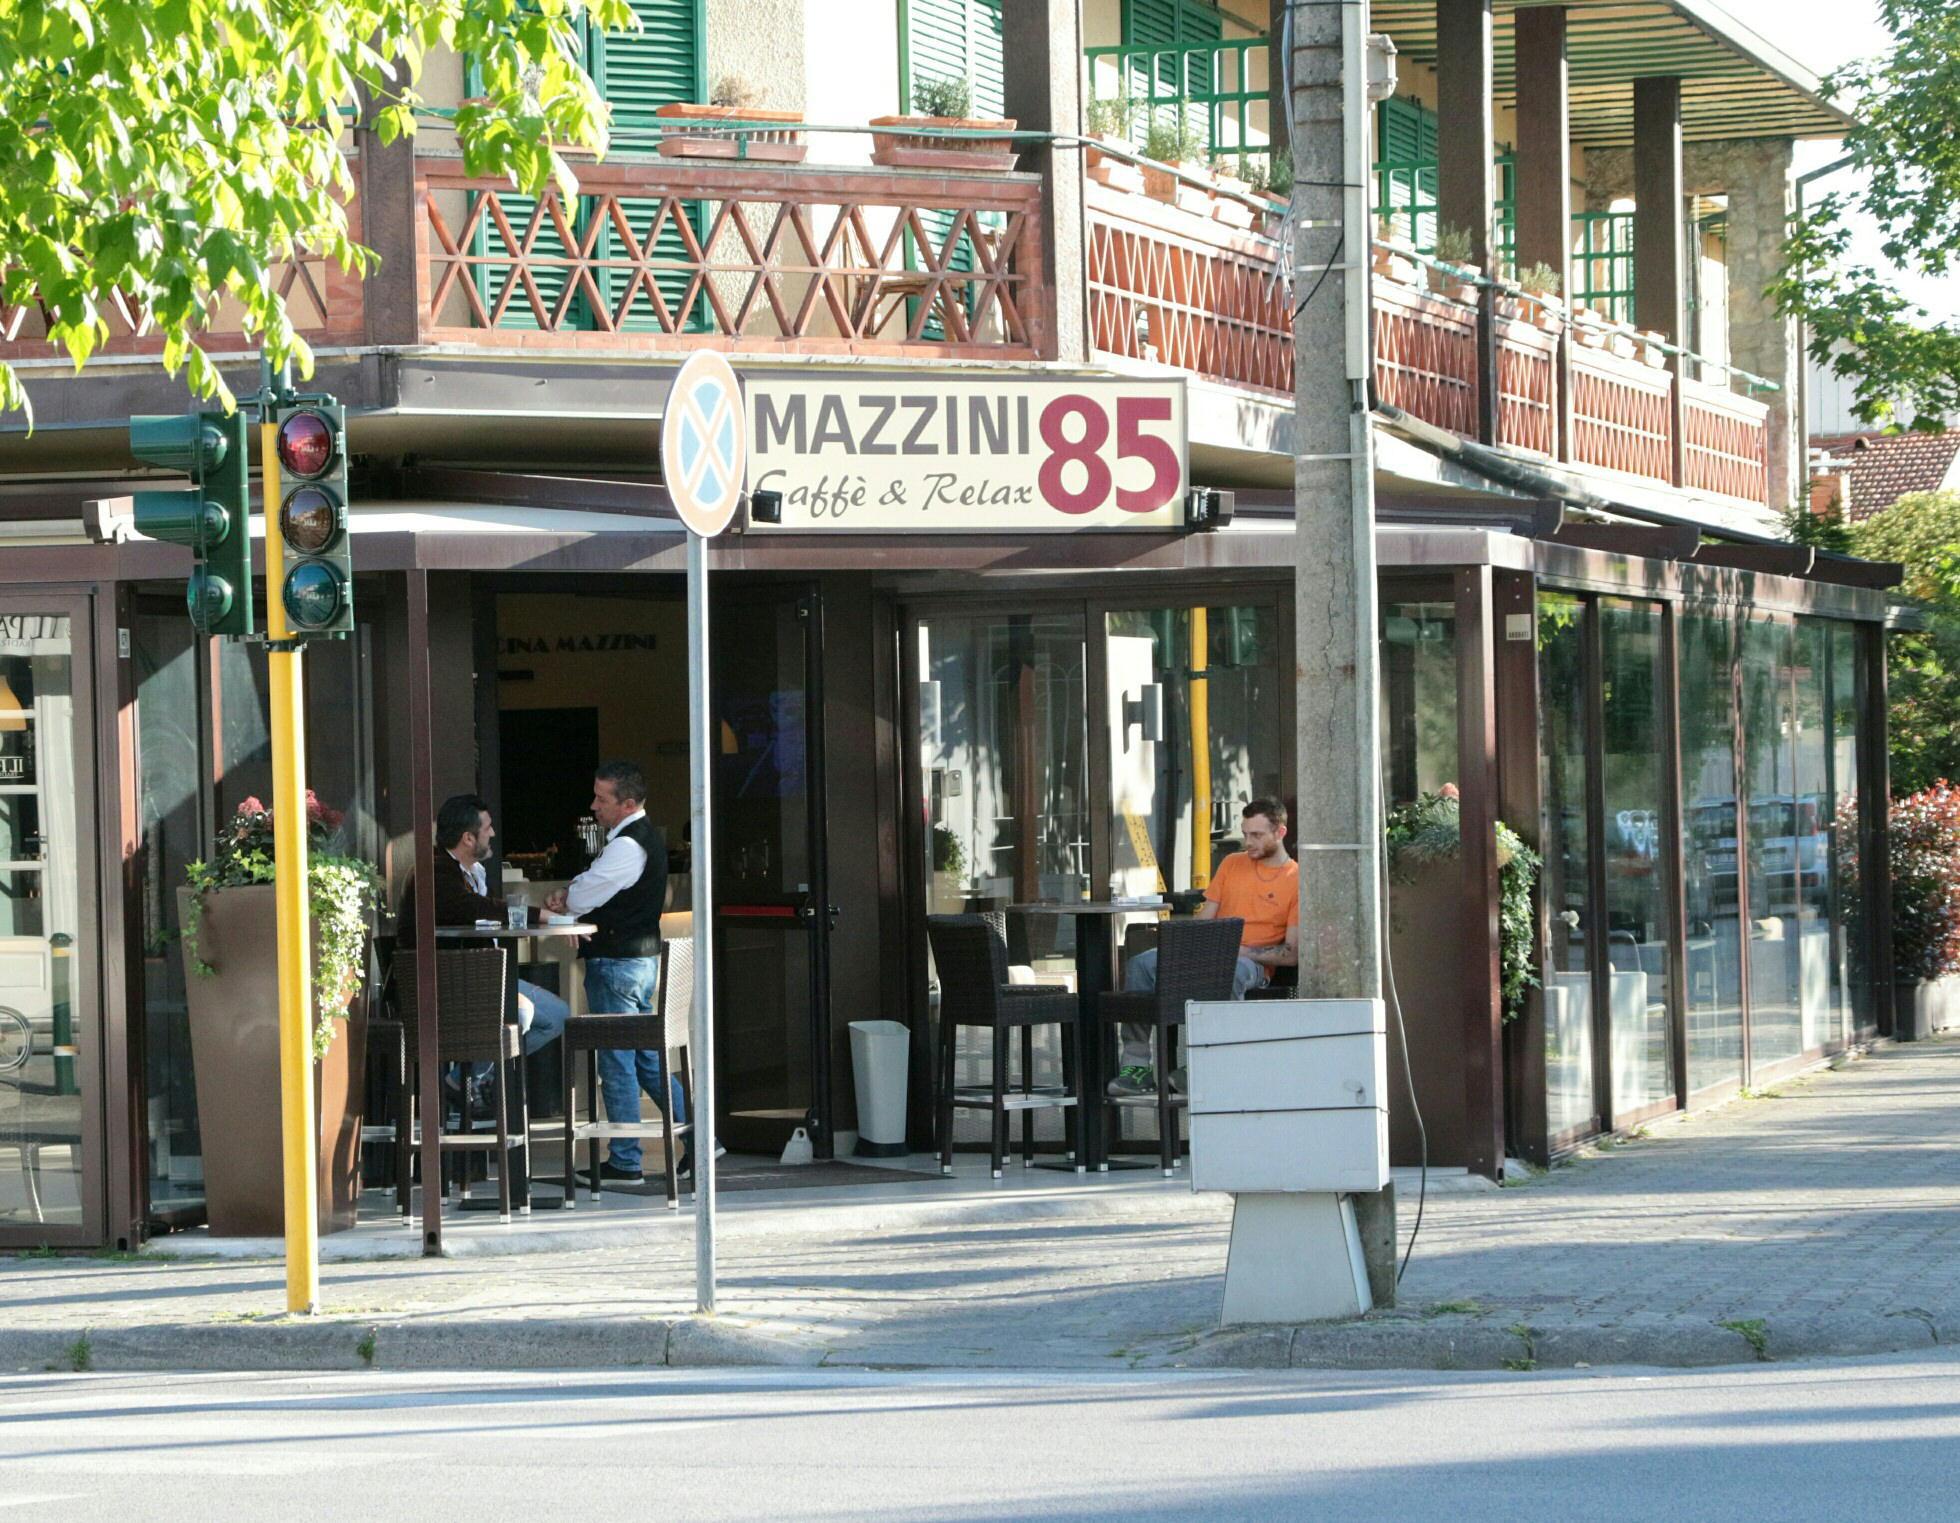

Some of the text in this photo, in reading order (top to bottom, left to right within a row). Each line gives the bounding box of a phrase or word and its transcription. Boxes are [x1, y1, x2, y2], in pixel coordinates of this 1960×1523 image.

[755, 393, 1181, 514] MAZZINI 85
[878, 480, 907, 506] &
[922, 472, 1033, 511] Relax
[556, 633, 657, 653] MAZZINI
